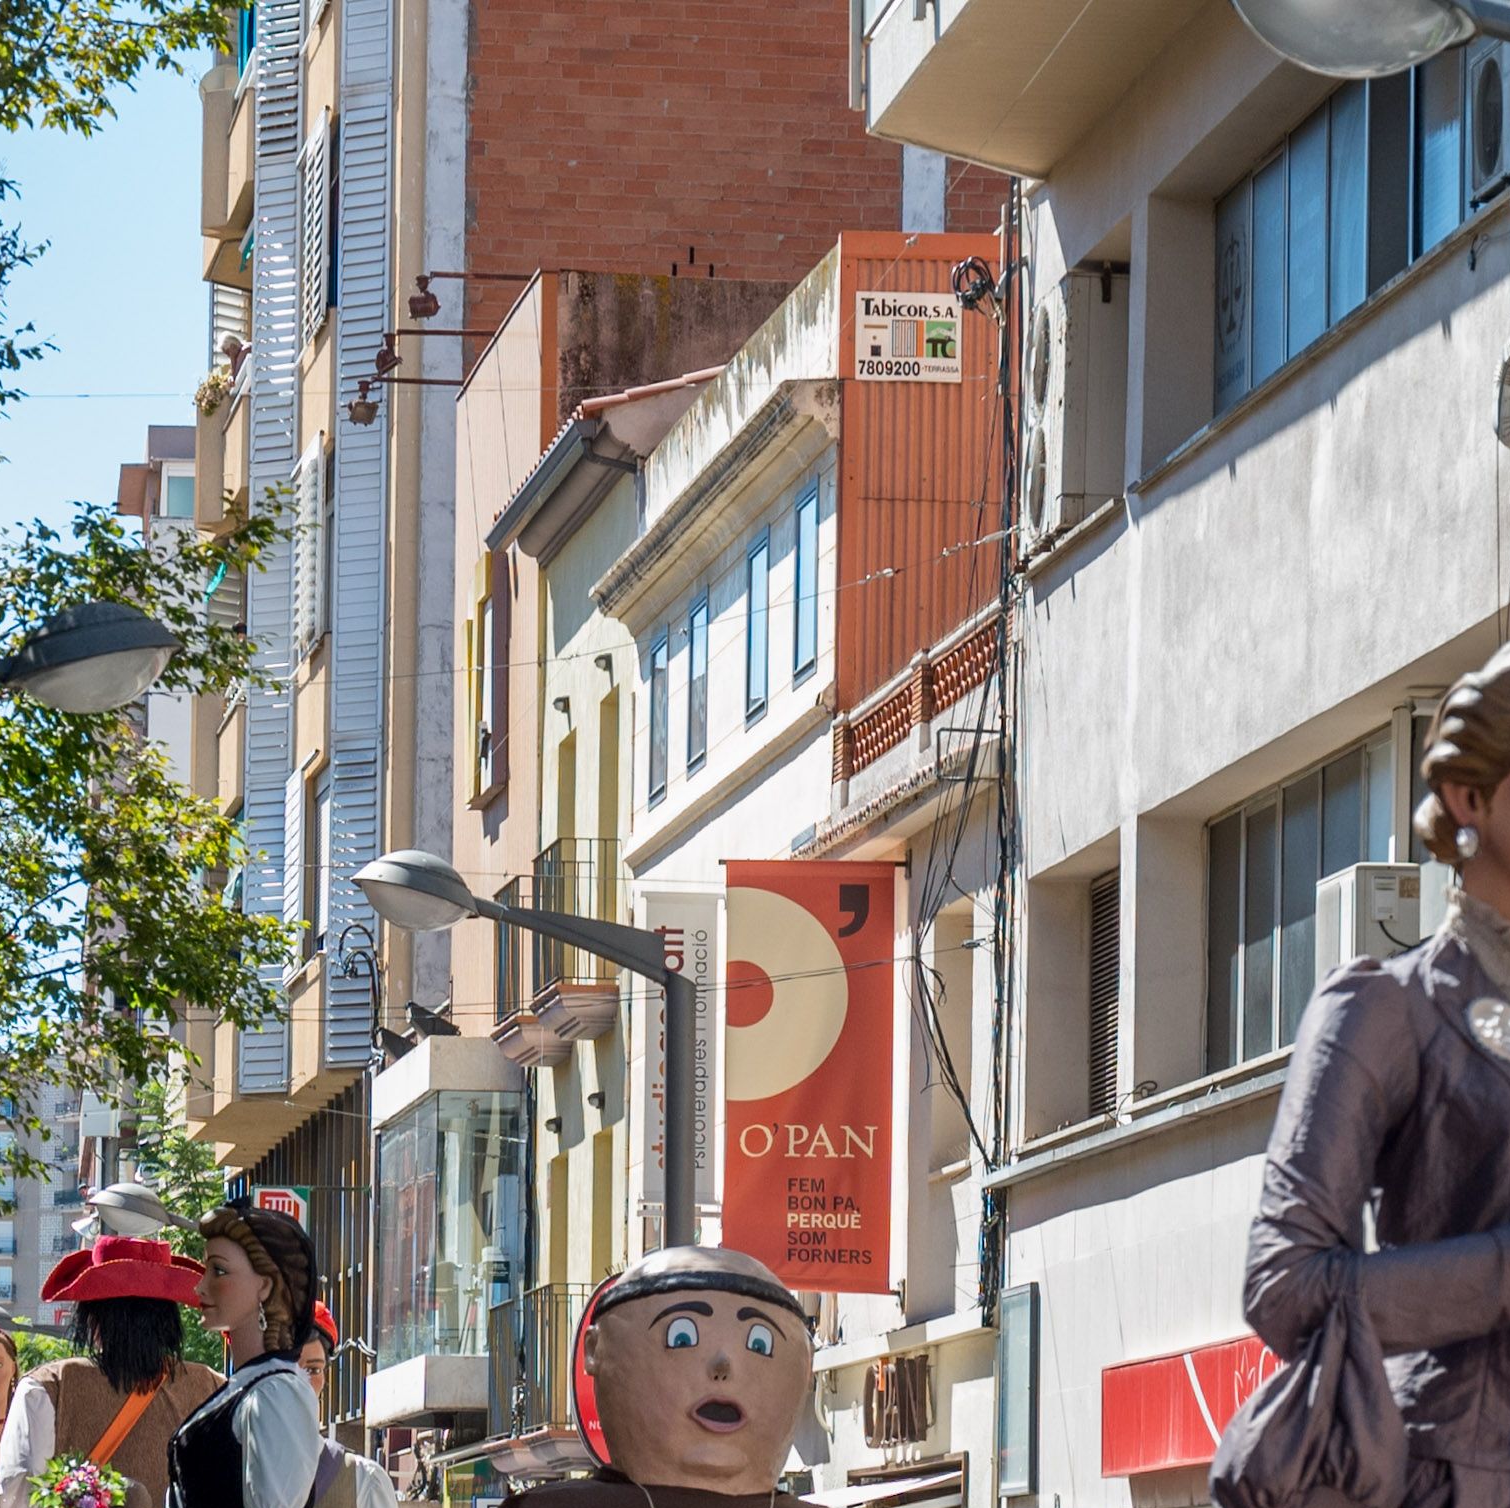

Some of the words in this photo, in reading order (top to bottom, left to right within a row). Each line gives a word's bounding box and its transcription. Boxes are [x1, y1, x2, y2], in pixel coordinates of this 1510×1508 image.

[858, 360, 921, 376] 7809200
[739, 1122, 879, 1159] O'PAN
[787, 1178, 825, 1193] FEM
[787, 1196, 826, 1211] BON
[833, 1196, 861, 1212] PA,
[786, 1210, 862, 1229] PERQUÈ
[787, 1231, 827, 1245] SOM
[787, 1248, 873, 1265] FORNERS
